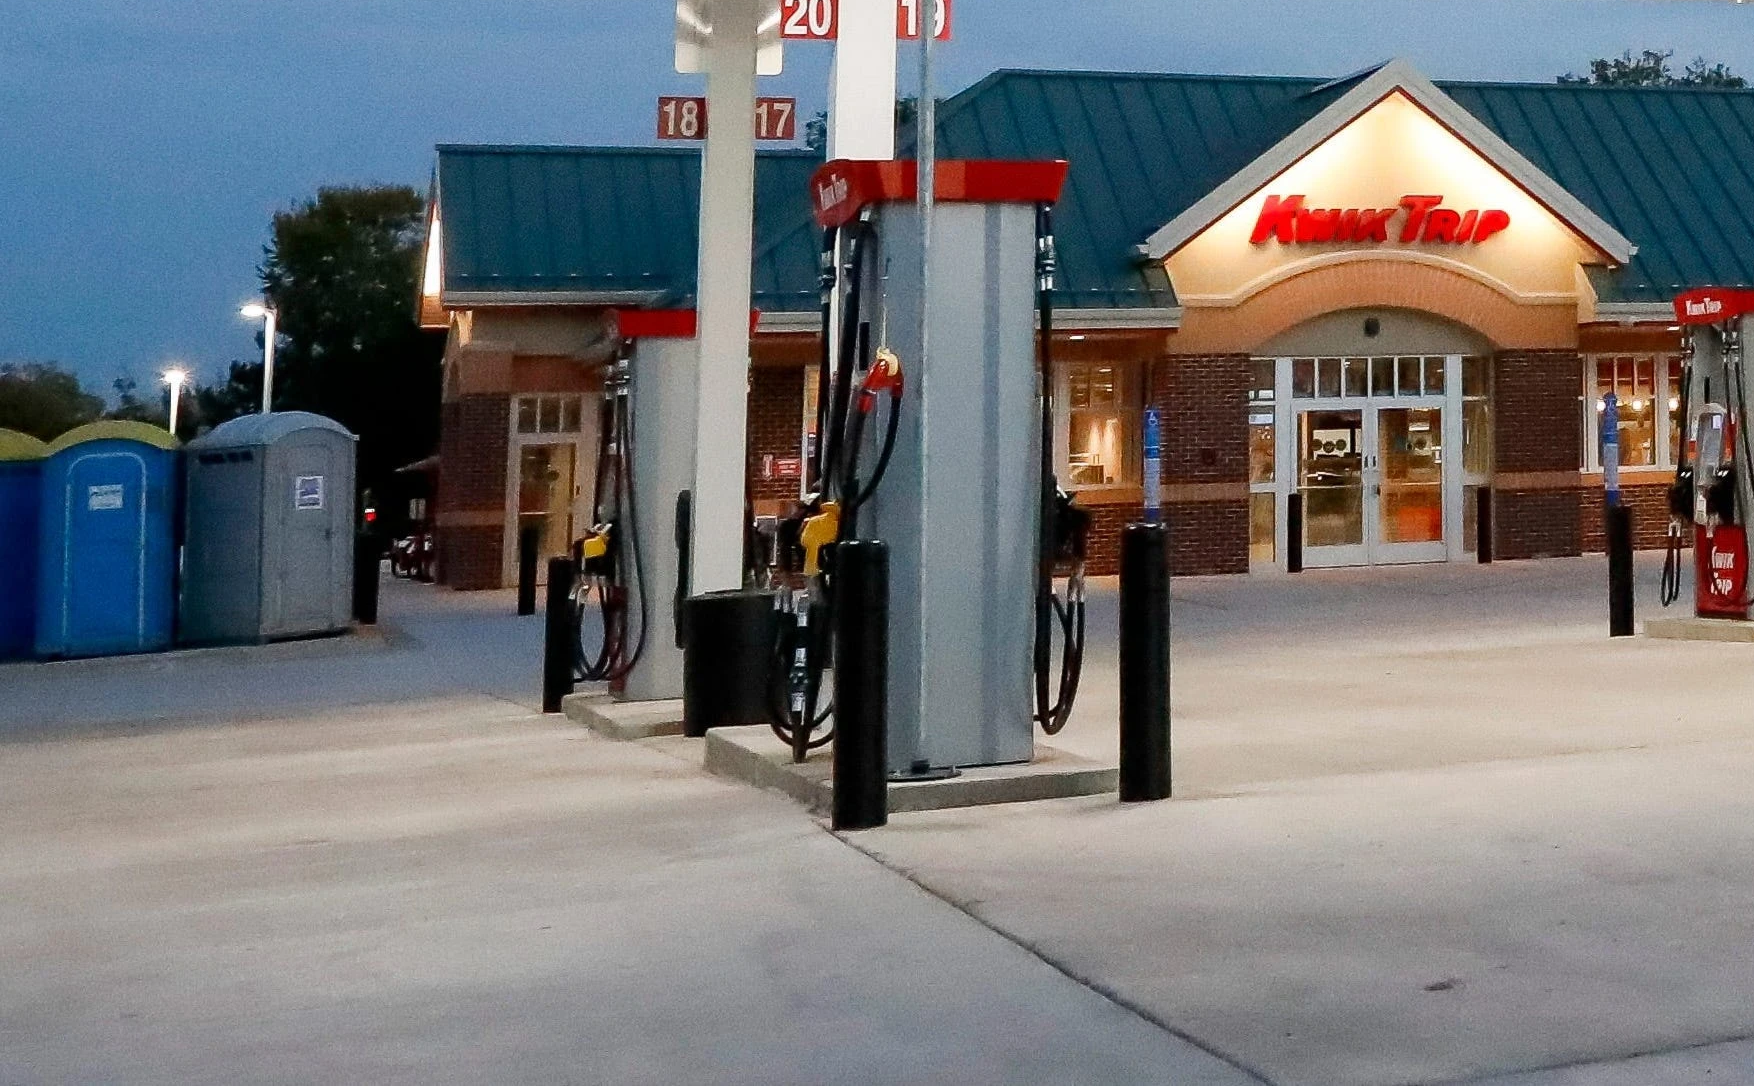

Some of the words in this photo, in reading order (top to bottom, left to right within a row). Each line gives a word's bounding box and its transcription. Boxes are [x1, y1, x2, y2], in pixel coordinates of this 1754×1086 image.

[663, 100, 698, 137] 18
[756, 102, 792, 138] 17
[1249, 195, 1398, 244] KWIK
[1399, 195, 1511, 244] TRIP
